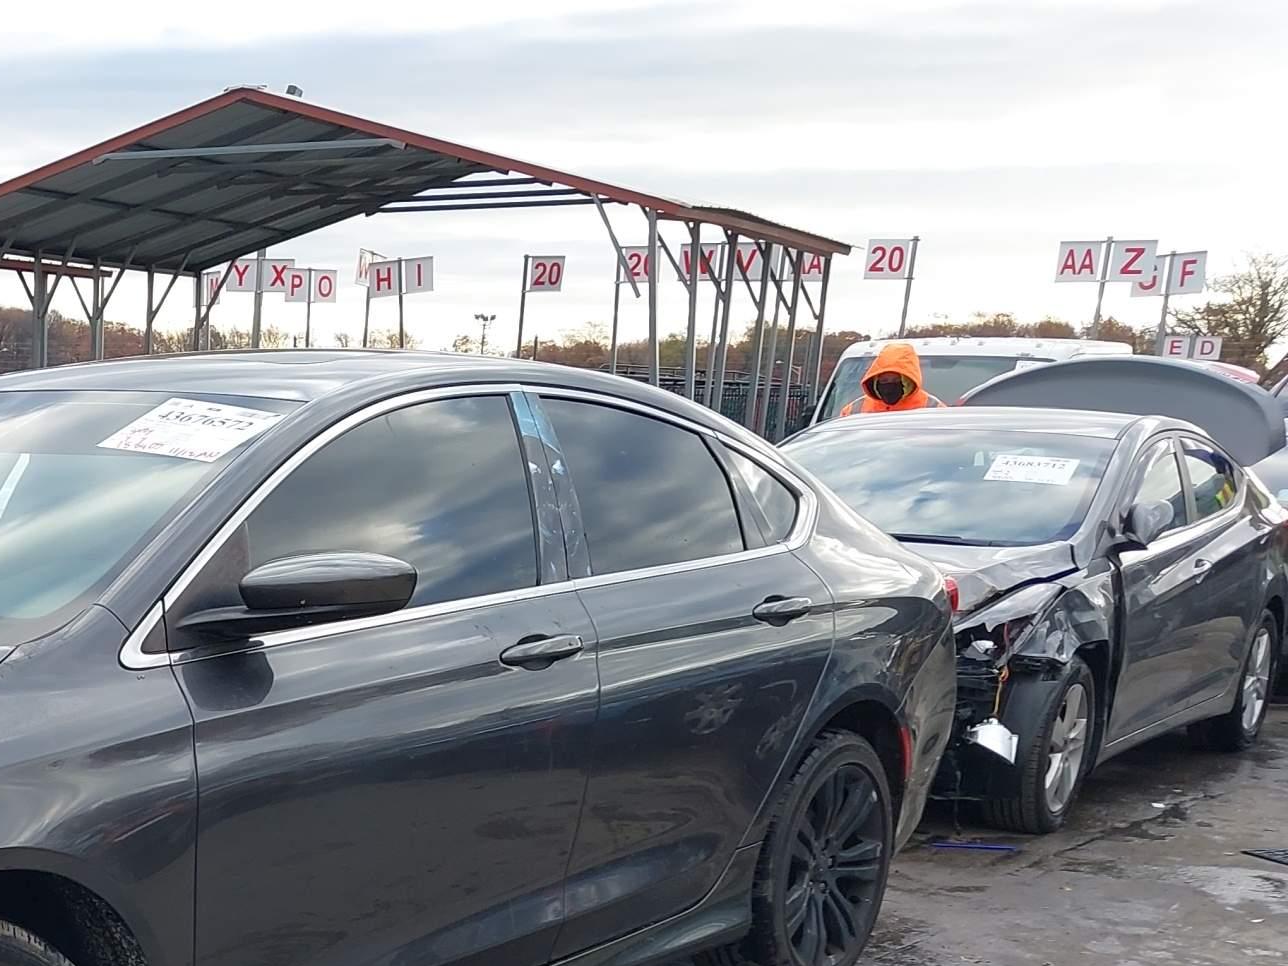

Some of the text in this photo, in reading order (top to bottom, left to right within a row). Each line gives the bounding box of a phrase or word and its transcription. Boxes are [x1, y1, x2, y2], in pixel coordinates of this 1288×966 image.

[868, 246, 905, 273] 20
[1059, 248, 1095, 275] AA
[1120, 247, 1146, 275] Z
[233, 265, 250, 286] Y
[270, 265, 288, 286] X
[376, 267, 392, 291] H
[535, 262, 561, 286] 20
[1180, 259, 1198, 288] F
[291, 274, 303, 297] P
[318, 275, 332, 298] O
[1169, 339, 1183, 355] E
[1199, 340, 1215, 356] D
[158, 410, 254, 431] 43676572
